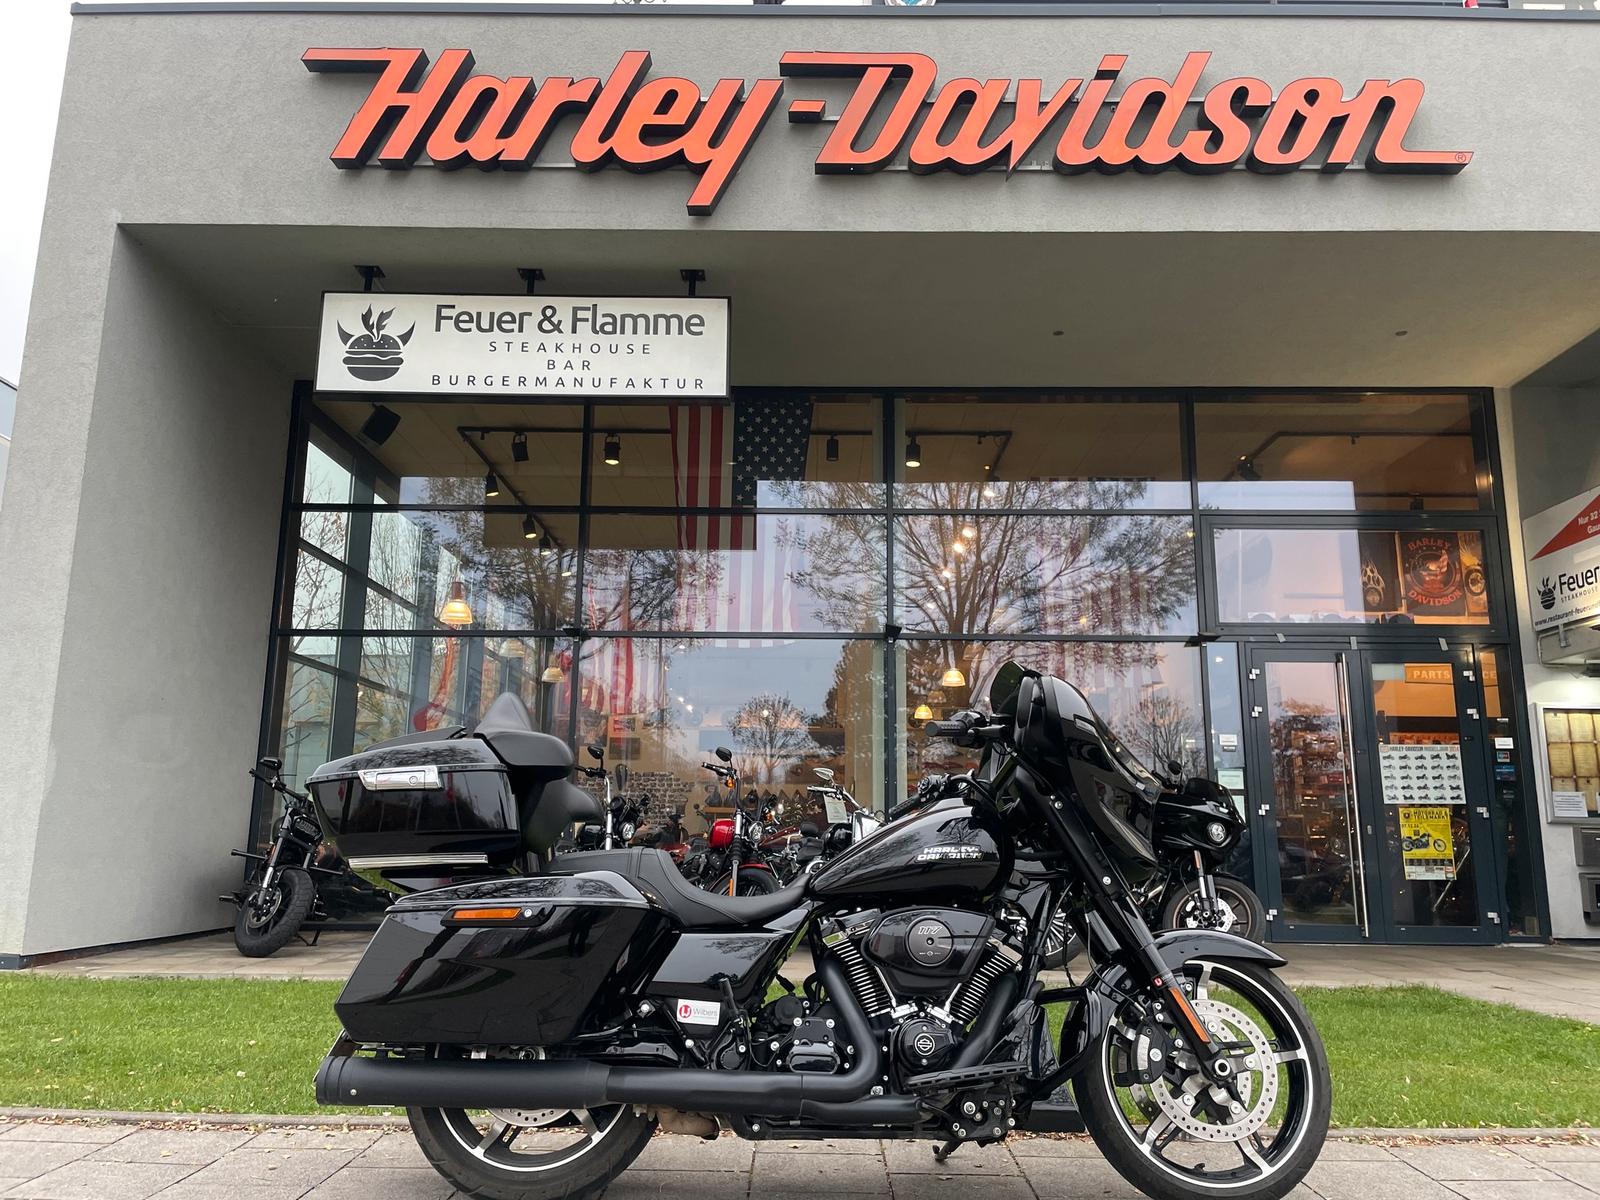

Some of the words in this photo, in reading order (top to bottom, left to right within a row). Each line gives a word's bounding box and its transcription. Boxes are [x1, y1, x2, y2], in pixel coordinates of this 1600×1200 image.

[300, 48, 1473, 215] Harley-Davidson
[434, 304, 532, 334] Feuer
[537, 305, 563, 334] &
[571, 306, 705, 336] Flamme
[489, 341, 651, 355] STEAKHOUSE
[547, 359, 591, 371] BAR
[431, 375, 704, 390] BURGERMANUFAKTUR
[1558, 566, 1600, 595] Feuer
[1407, 588, 1462, 606] DAVIDSON
[1413, 670, 1451, 679] PARTS
[918, 925, 942, 934] 117
